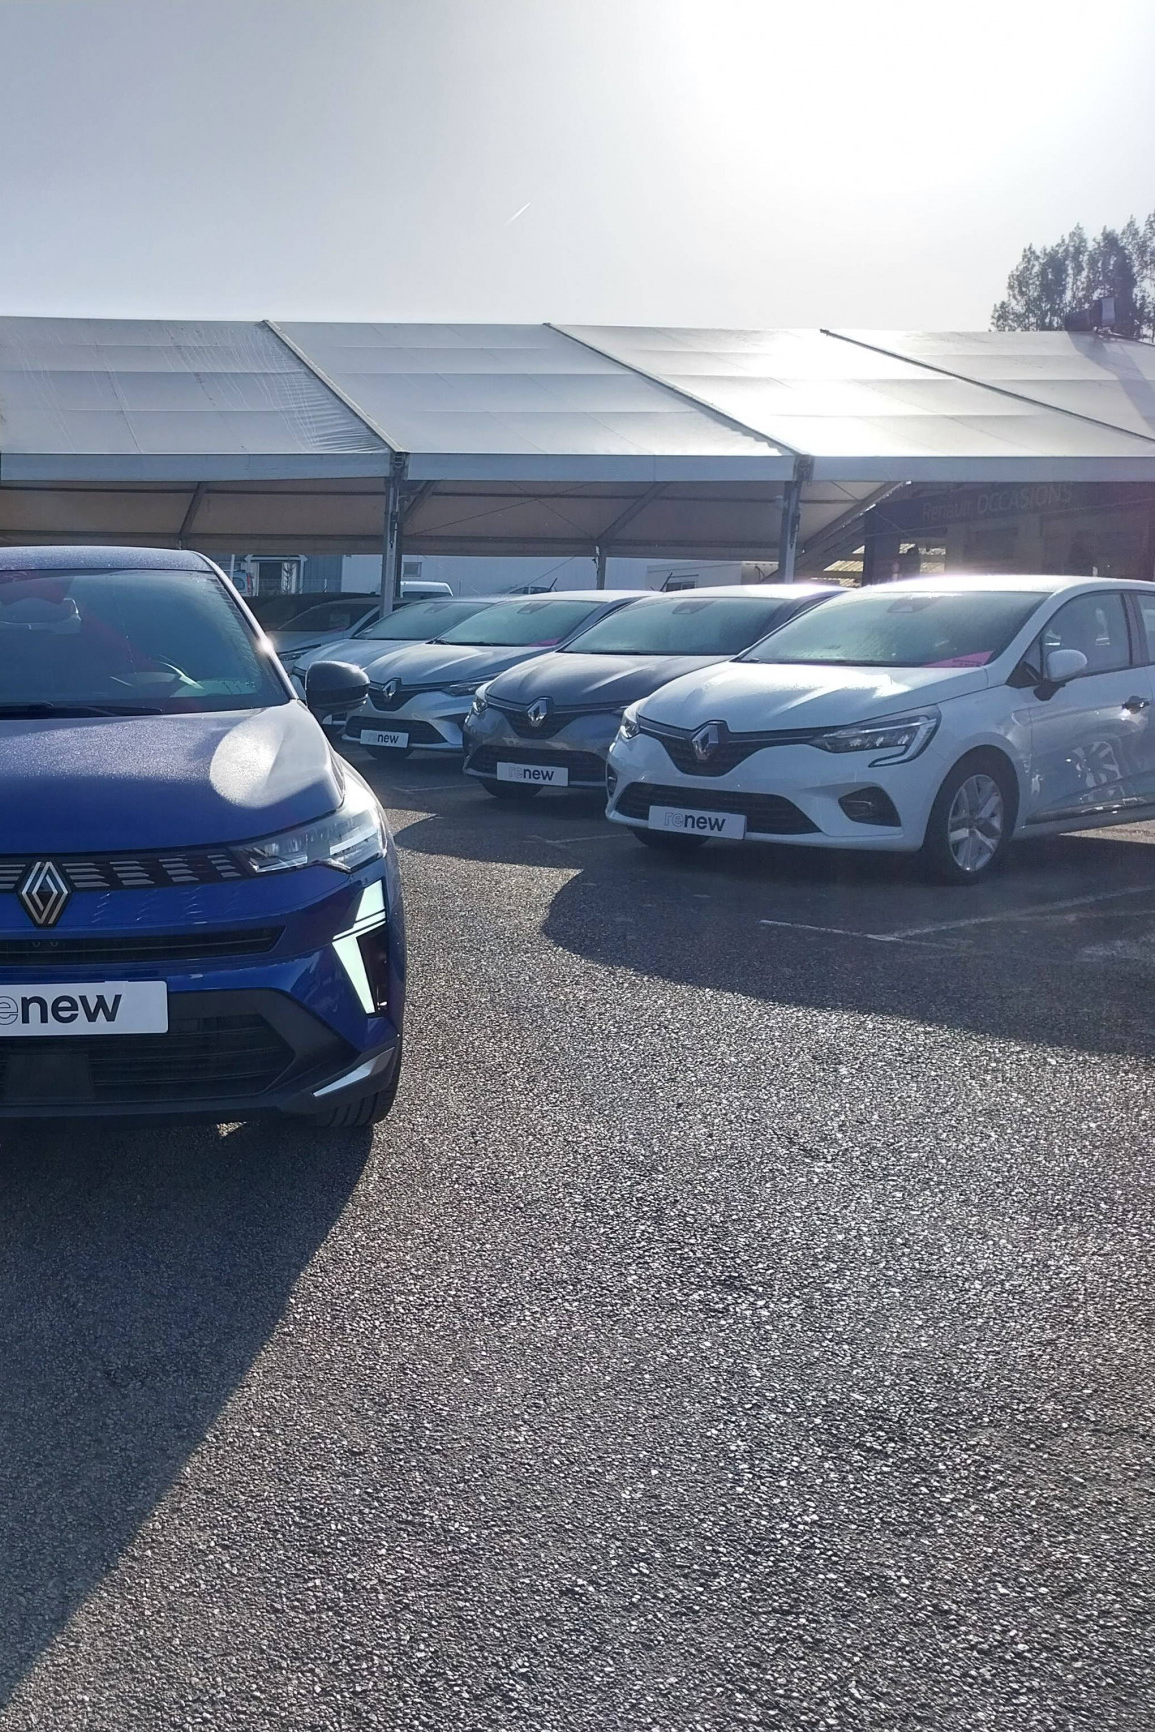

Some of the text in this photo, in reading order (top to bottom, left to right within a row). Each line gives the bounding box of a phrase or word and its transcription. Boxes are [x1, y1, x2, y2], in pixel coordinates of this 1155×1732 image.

[977, 482, 1073, 514] OCCASIONS
[508, 766, 555, 781] renew
[664, 811, 726, 832] renew
